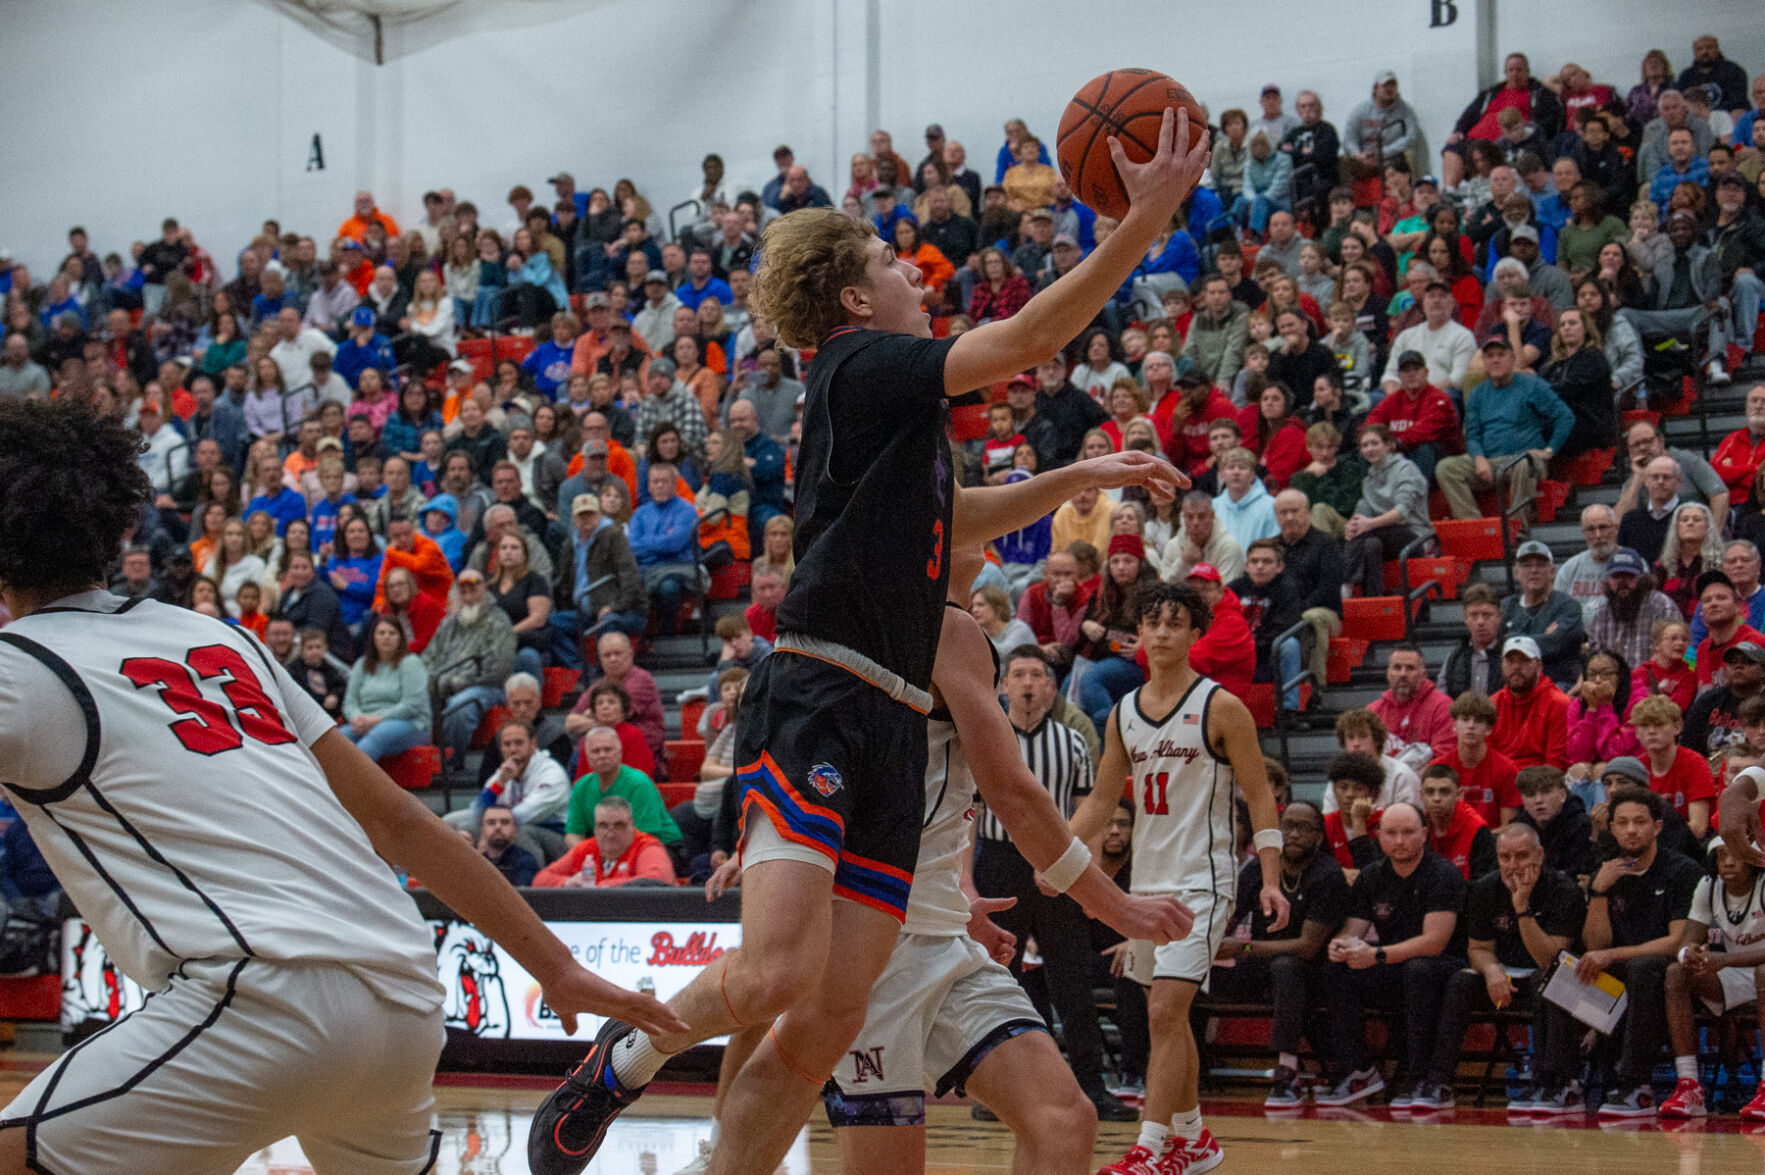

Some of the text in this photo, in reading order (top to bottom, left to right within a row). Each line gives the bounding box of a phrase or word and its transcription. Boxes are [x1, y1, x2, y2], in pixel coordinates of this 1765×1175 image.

[1429, 0, 1458, 28] B
[306, 133, 325, 171] A
[926, 519, 943, 580] 3
[118, 643, 298, 757] 33
[1152, 739, 1199, 765] Albany
[1144, 772, 1169, 815] 11
[586, 937, 608, 969] of
[611, 938, 641, 964] the
